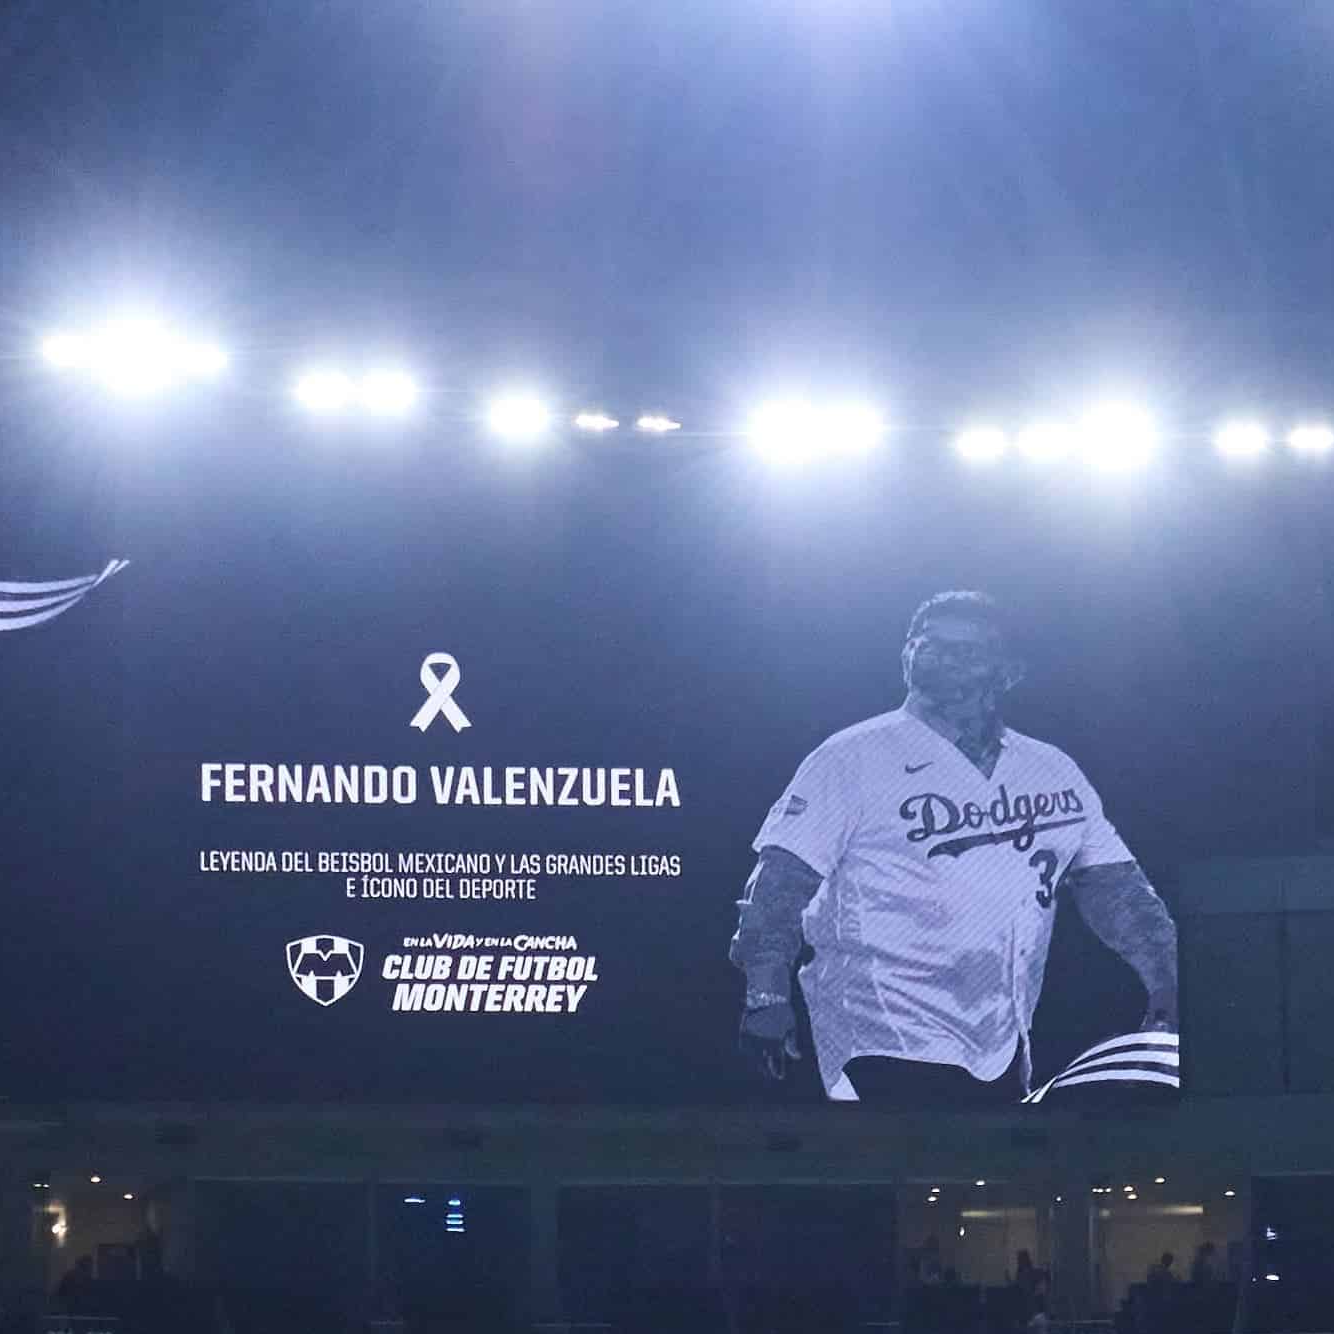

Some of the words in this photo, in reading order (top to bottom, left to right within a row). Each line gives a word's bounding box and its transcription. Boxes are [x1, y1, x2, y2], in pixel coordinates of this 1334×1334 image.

[201, 763, 417, 804] FERNANDO
[430, 765, 681, 807] VALENZUELA
[899, 785, 1085, 855] Dodgers
[200, 851, 277, 872] LEYENDA
[282, 852, 314, 873] DEL
[318, 852, 394, 873] BEISBOL
[398, 853, 491, 874] MEXICANO
[494, 853, 507, 874] Y
[510, 853, 541, 874] LAS
[545, 854, 626, 876] GRANDES
[631, 854, 681, 876] LIGAS
[347, 877, 356, 898] E
[361, 875, 418, 898] ÍCONO
[422, 878, 454, 899] DEL
[459, 878, 536, 900] DEPORTE
[403, 936, 419, 948] EN
[419, 936, 433, 949] LA
[432, 933, 475, 949] VIDA
[483, 937, 500, 948] EN
[499, 937, 513, 948] LA
[513, 935, 578, 950] CANCHA
[382, 955, 453, 980] CLUB
[457, 956, 495, 981] DE
[498, 956, 599, 981] FUTBOL
[392, 984, 587, 1012] MONTERREY
